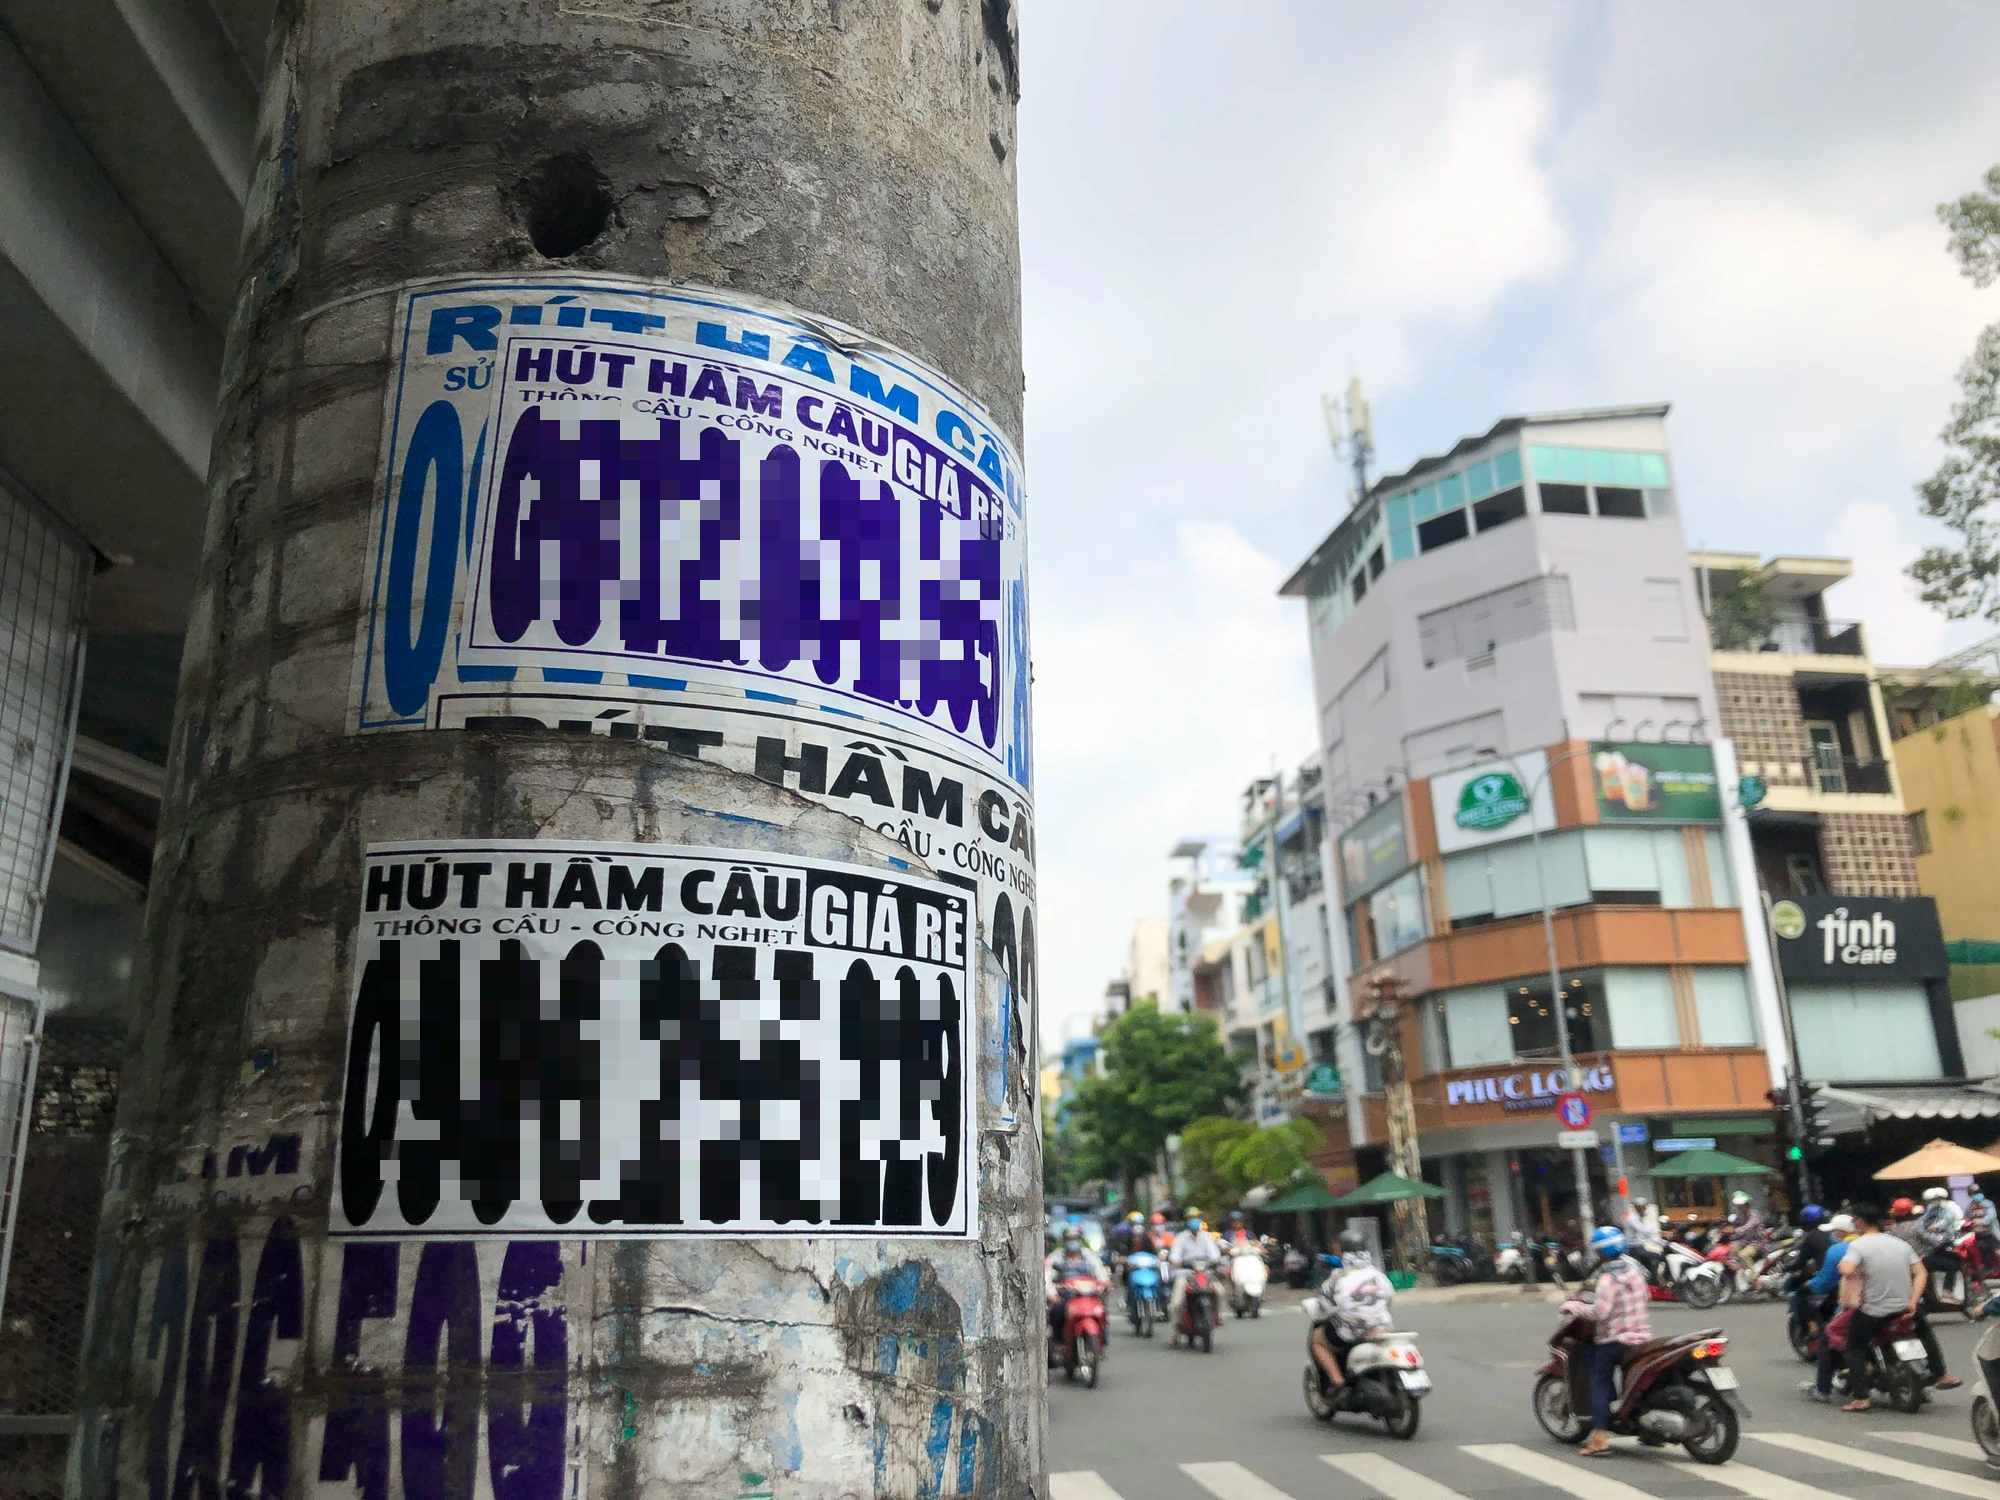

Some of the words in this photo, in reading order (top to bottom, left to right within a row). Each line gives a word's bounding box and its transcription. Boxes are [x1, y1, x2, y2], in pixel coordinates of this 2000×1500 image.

[515, 345, 635, 388] HÚT
[648, 363, 783, 419] HẦM
[796, 395, 889, 457] CẦU
[895, 439, 962, 517] GIÁ
[632, 397, 692, 418] CẦU
[716, 413, 793, 442] CỐNG
[803, 435, 883, 474] NGHẸT
[754, 736, 963, 828] HẦM
[953, 837, 1005, 882] CỐNG
[365, 857, 492, 912] HÚT
[505, 857, 665, 912] HẦM
[680, 866, 801, 921] CẦU
[810, 884, 903, 954] GIÁ
[915, 899, 964, 966] RẺ
[374, 915, 481, 936] THÔNG
[492, 913, 561, 934] CẦU
[593, 914, 684, 938] CỐNG
[697, 924, 798, 947] NGHẸT
[1841, 944, 1897, 964] Cafe
